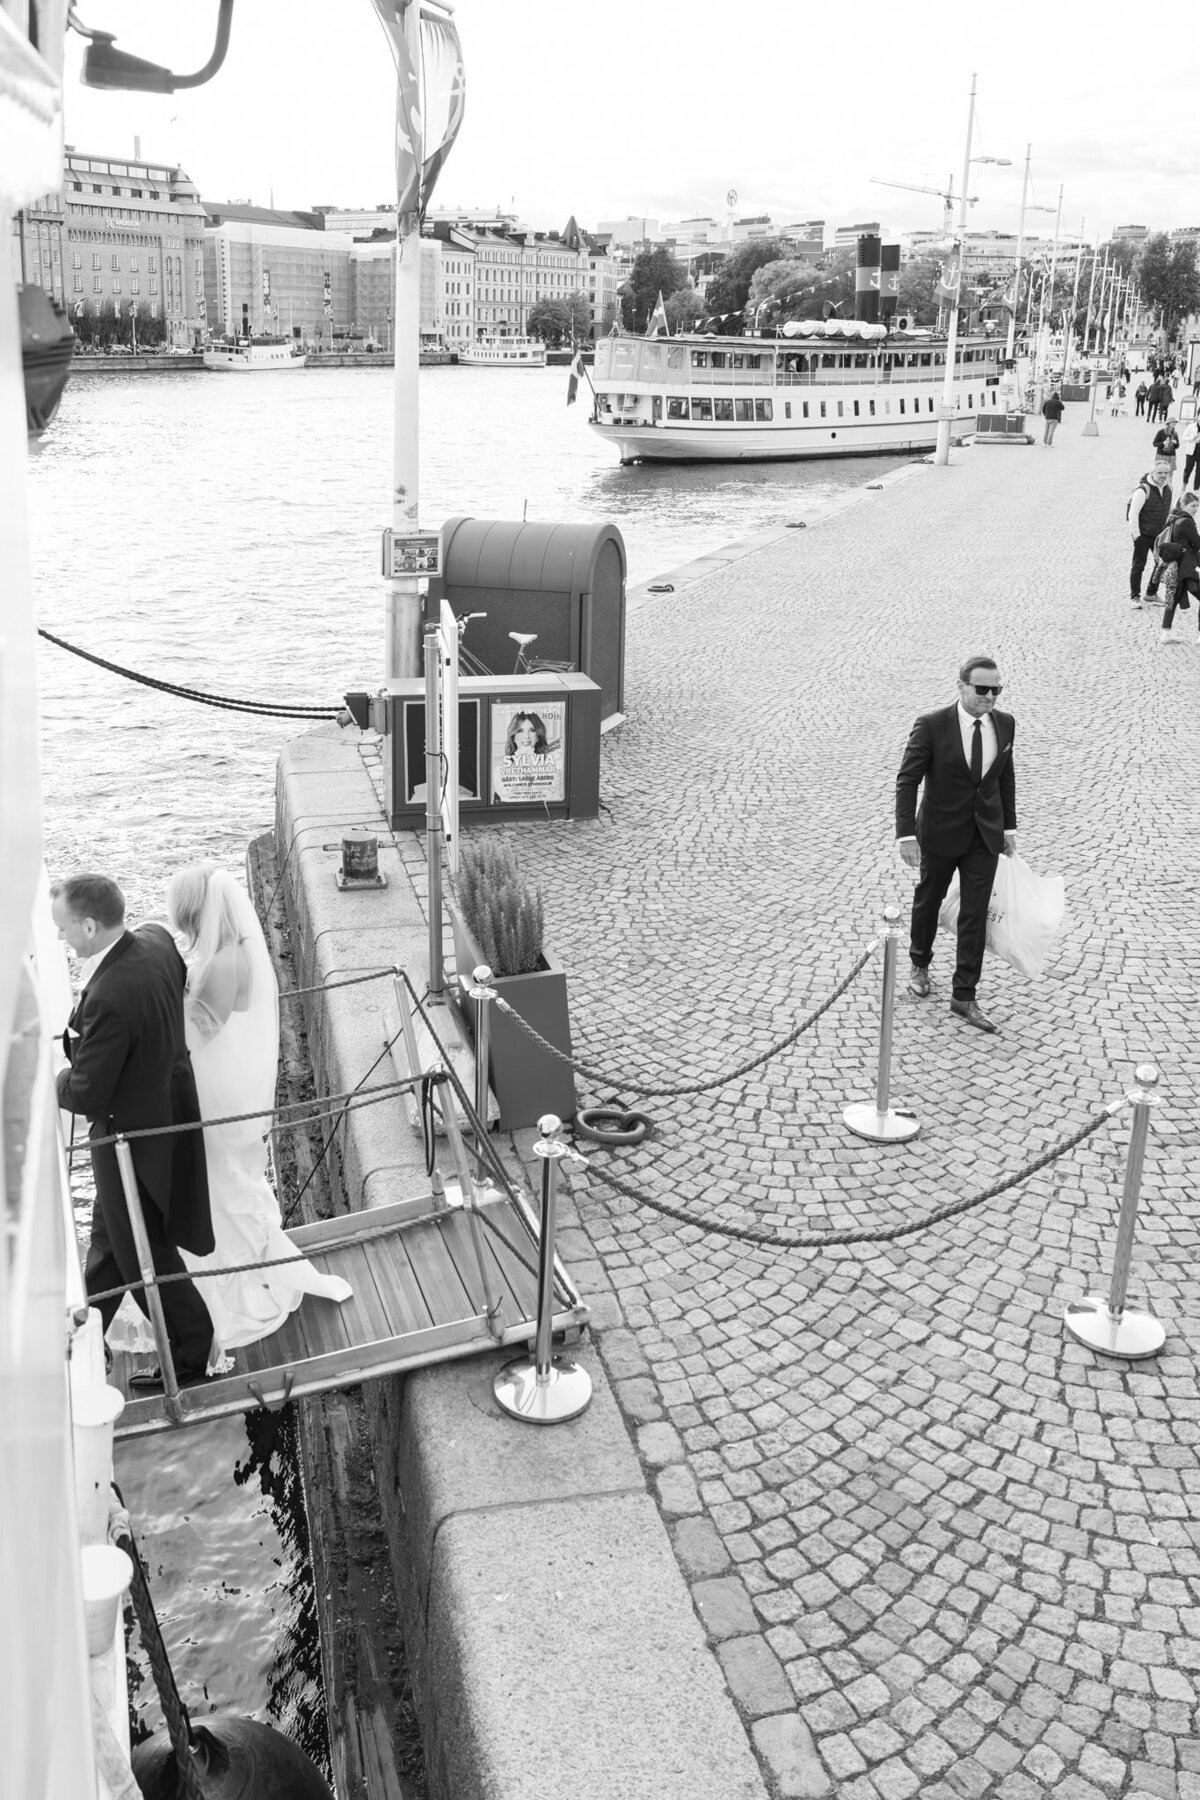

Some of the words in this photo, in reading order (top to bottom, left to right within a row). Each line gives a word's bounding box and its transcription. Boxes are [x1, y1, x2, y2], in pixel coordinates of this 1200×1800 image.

[541, 712, 562, 721] 80th
[502, 754, 555, 767] SYLVIA
[501, 766, 556, 775] VRETHAMMAR
